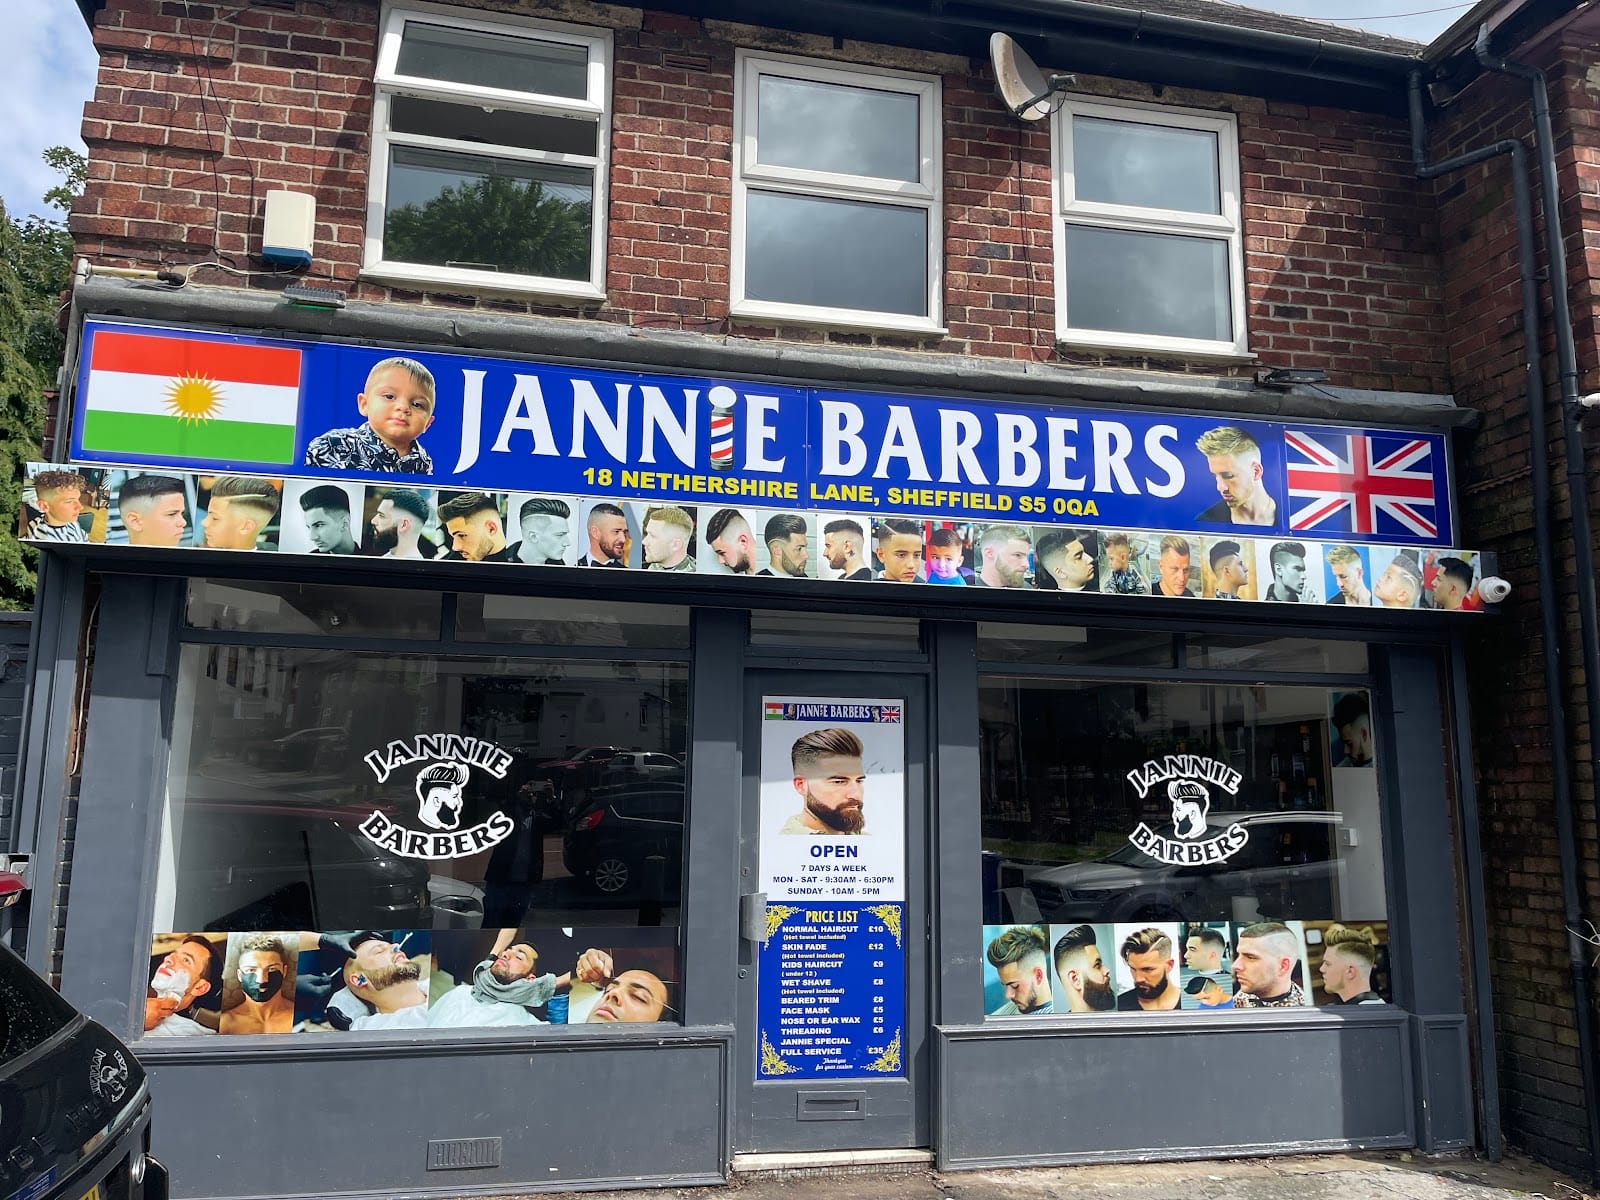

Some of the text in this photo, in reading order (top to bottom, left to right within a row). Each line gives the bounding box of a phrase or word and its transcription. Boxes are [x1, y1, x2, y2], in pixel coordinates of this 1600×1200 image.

[819, 400, 1186, 499] BARBERS
[583, 467, 613, 487] 18
[621, 470, 798, 499] NETHERSHIRE
[810, 482, 880, 506] LANE,
[887, 488, 1013, 512] SHEFFIELD
[1019, 496, 1047, 514] S5
[831, 705, 870, 718] BARBERS
[364, 734, 513, 783] JANNIE
[1127, 754, 1242, 798] JANNIE
[358, 810, 514, 860] BARBERS
[810, 845, 858, 858] OPEN
[1128, 822, 1248, 866] BARBERS
[805, 910, 858, 923] PRICE LIST
